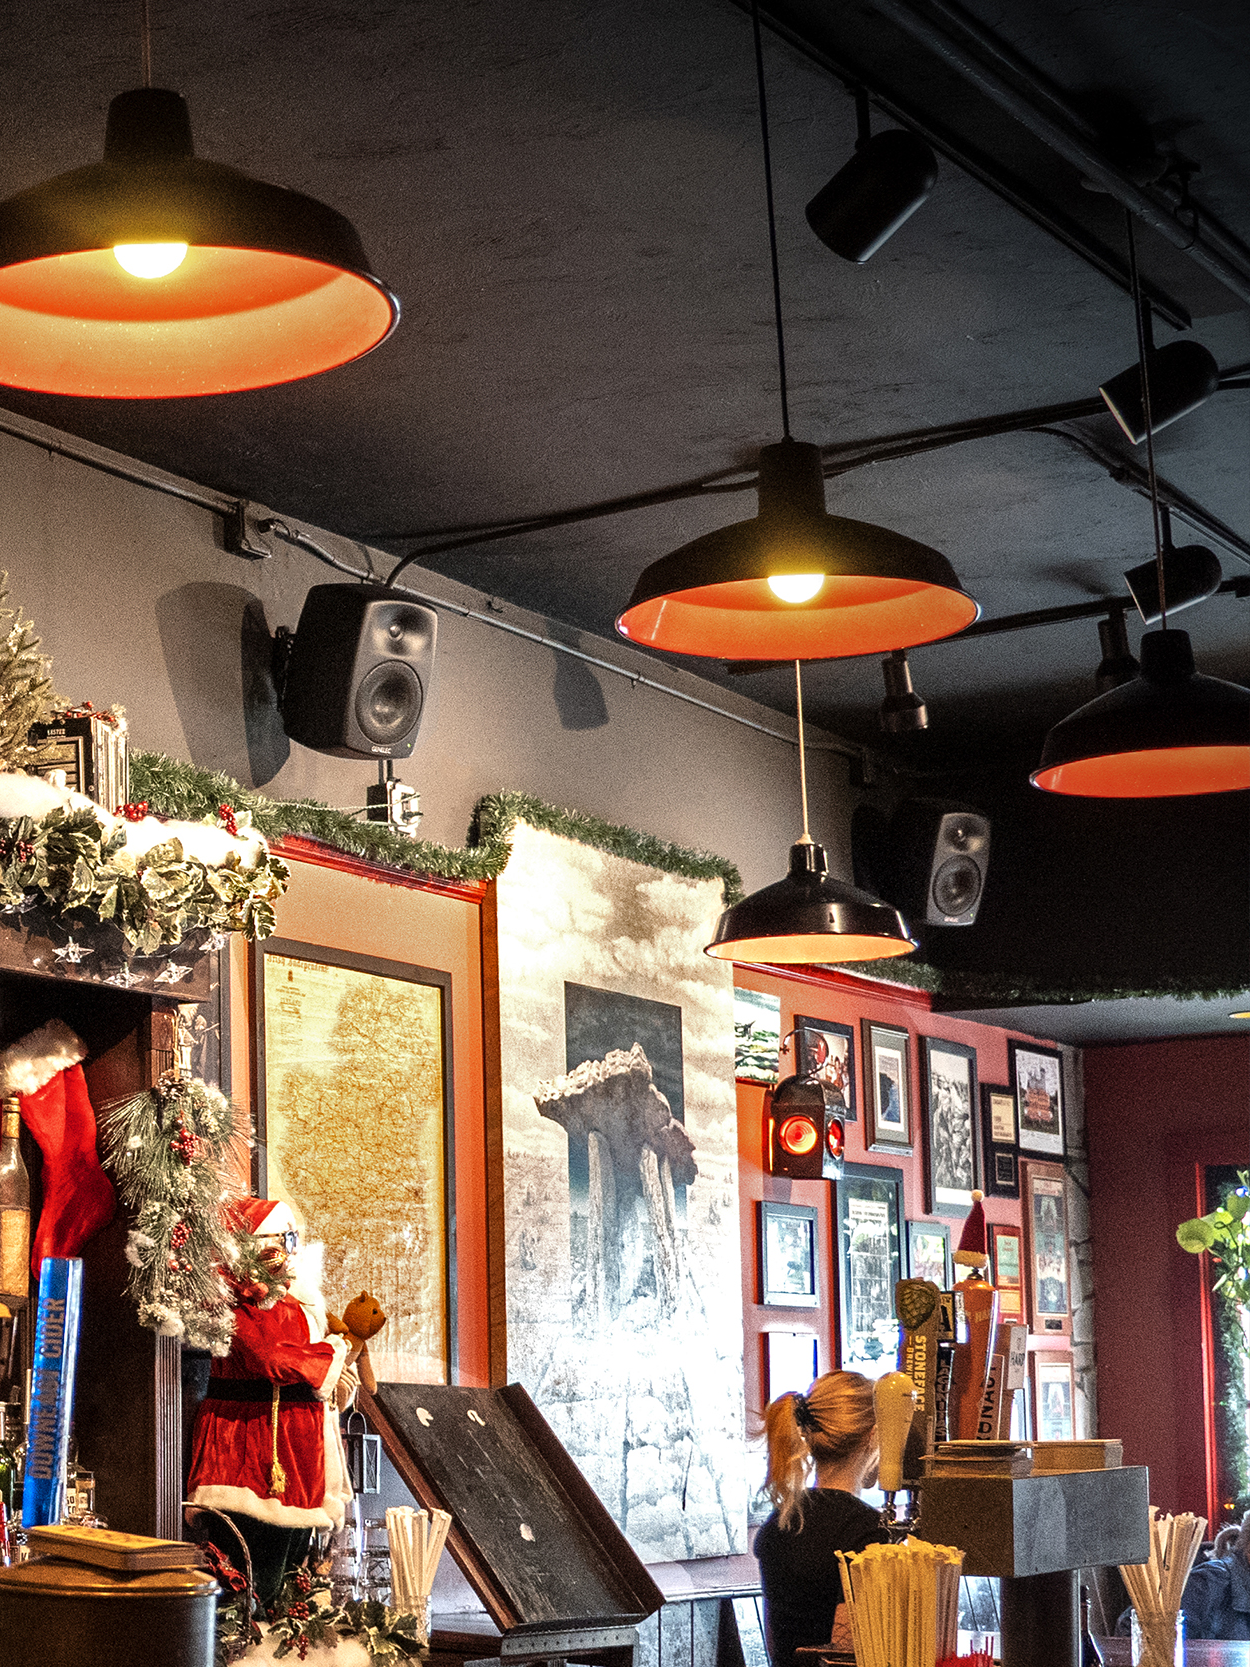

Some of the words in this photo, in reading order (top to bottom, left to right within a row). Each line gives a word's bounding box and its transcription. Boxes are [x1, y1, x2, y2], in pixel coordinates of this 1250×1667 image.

[40, 1297, 66, 1359] CIDER
[905, 1348, 915, 1379] BREWI
[913, 1334, 927, 1412] STONEFACE
